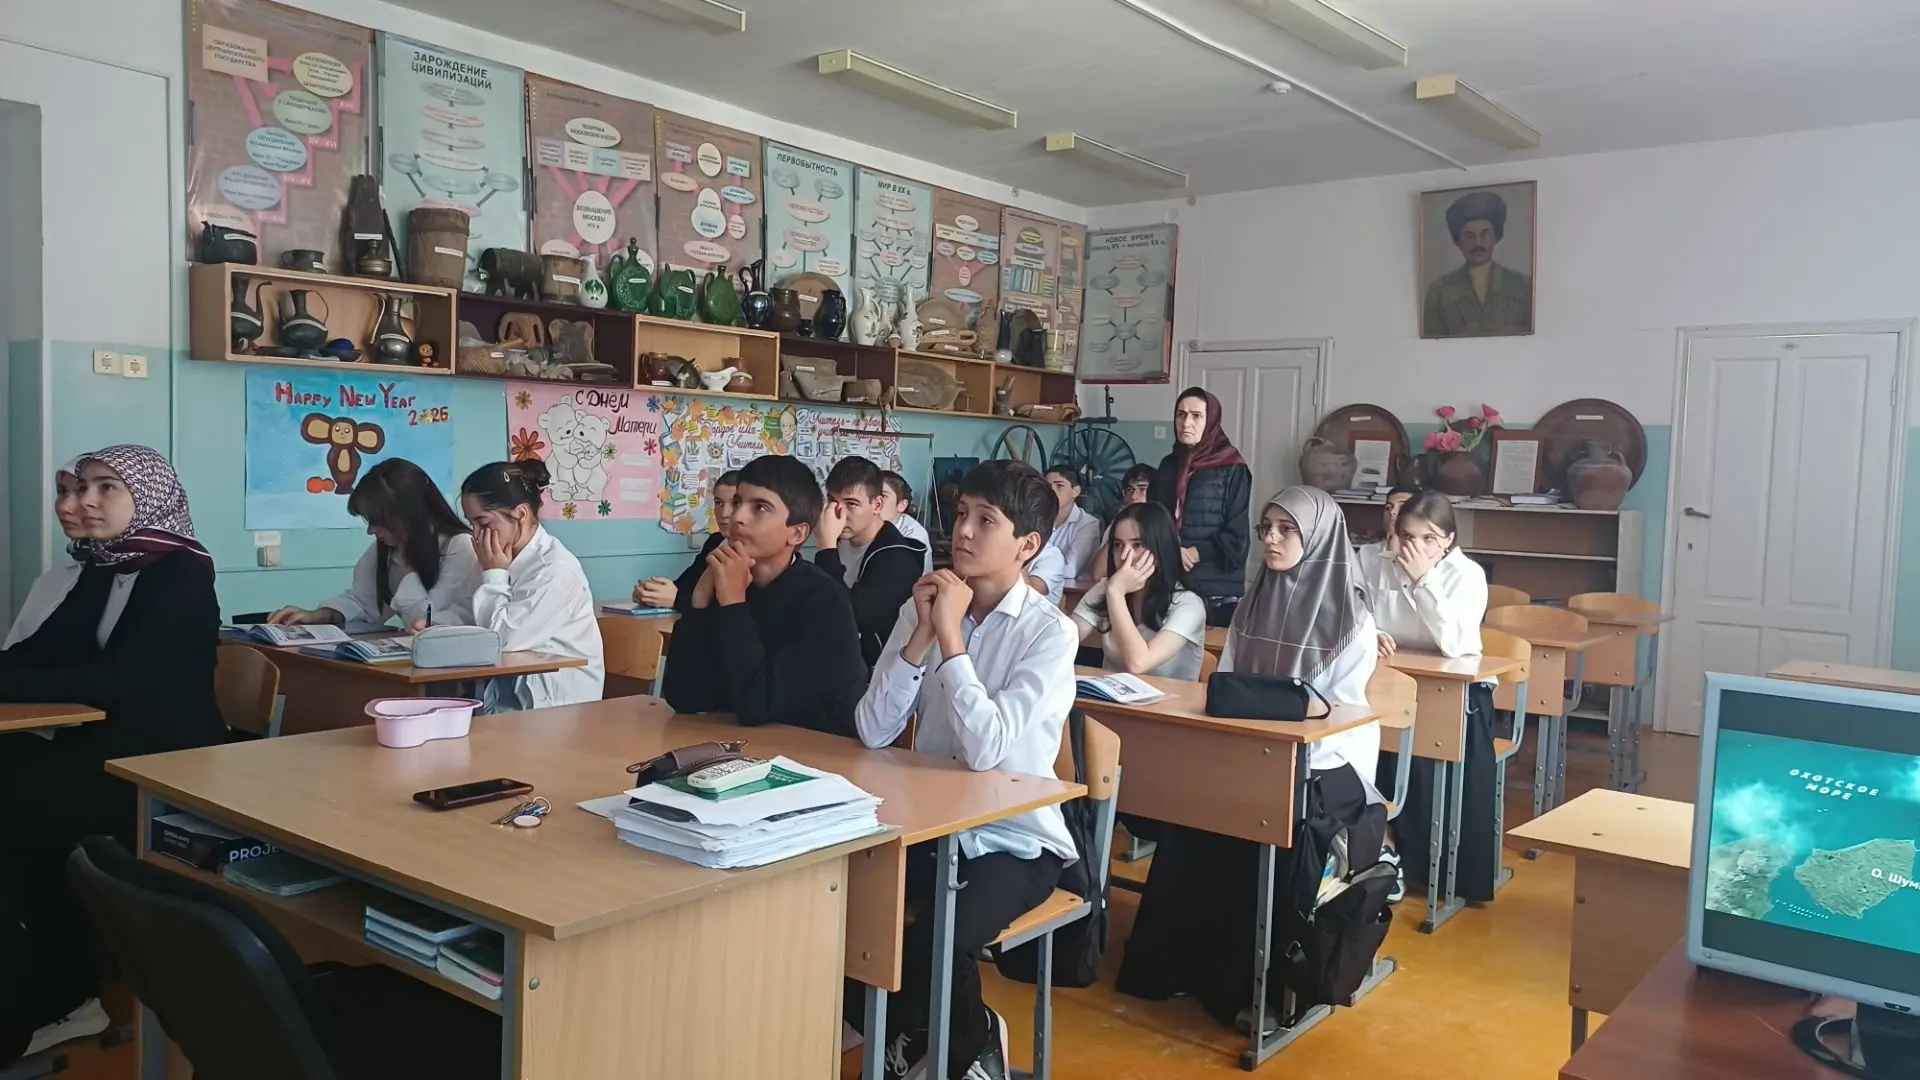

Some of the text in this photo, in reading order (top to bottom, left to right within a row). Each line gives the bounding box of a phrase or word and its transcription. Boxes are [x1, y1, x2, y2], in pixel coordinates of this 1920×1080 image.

[411, 60, 492, 90] ЦИВИЛИЗАЦИЙ
[414, 51, 488, 78] ЗАРОЖДЕНИЕ
[776, 153, 839, 177] ПЕРВОБЫТНОСТЬ
[878, 180, 892, 191] МИР
[1105, 232, 1154, 244] НОВОЕ ВРЕМЯ
[575, 389, 585, 405] С
[608, 416, 657, 438] Матери
[727, 434, 764, 449] Учитель
[1789, 769, 1880, 796] ОХОТСКОЕ
[1805, 783, 1853, 800] МОРЕ
[1871, 868, 1920, 891] О. Шум
